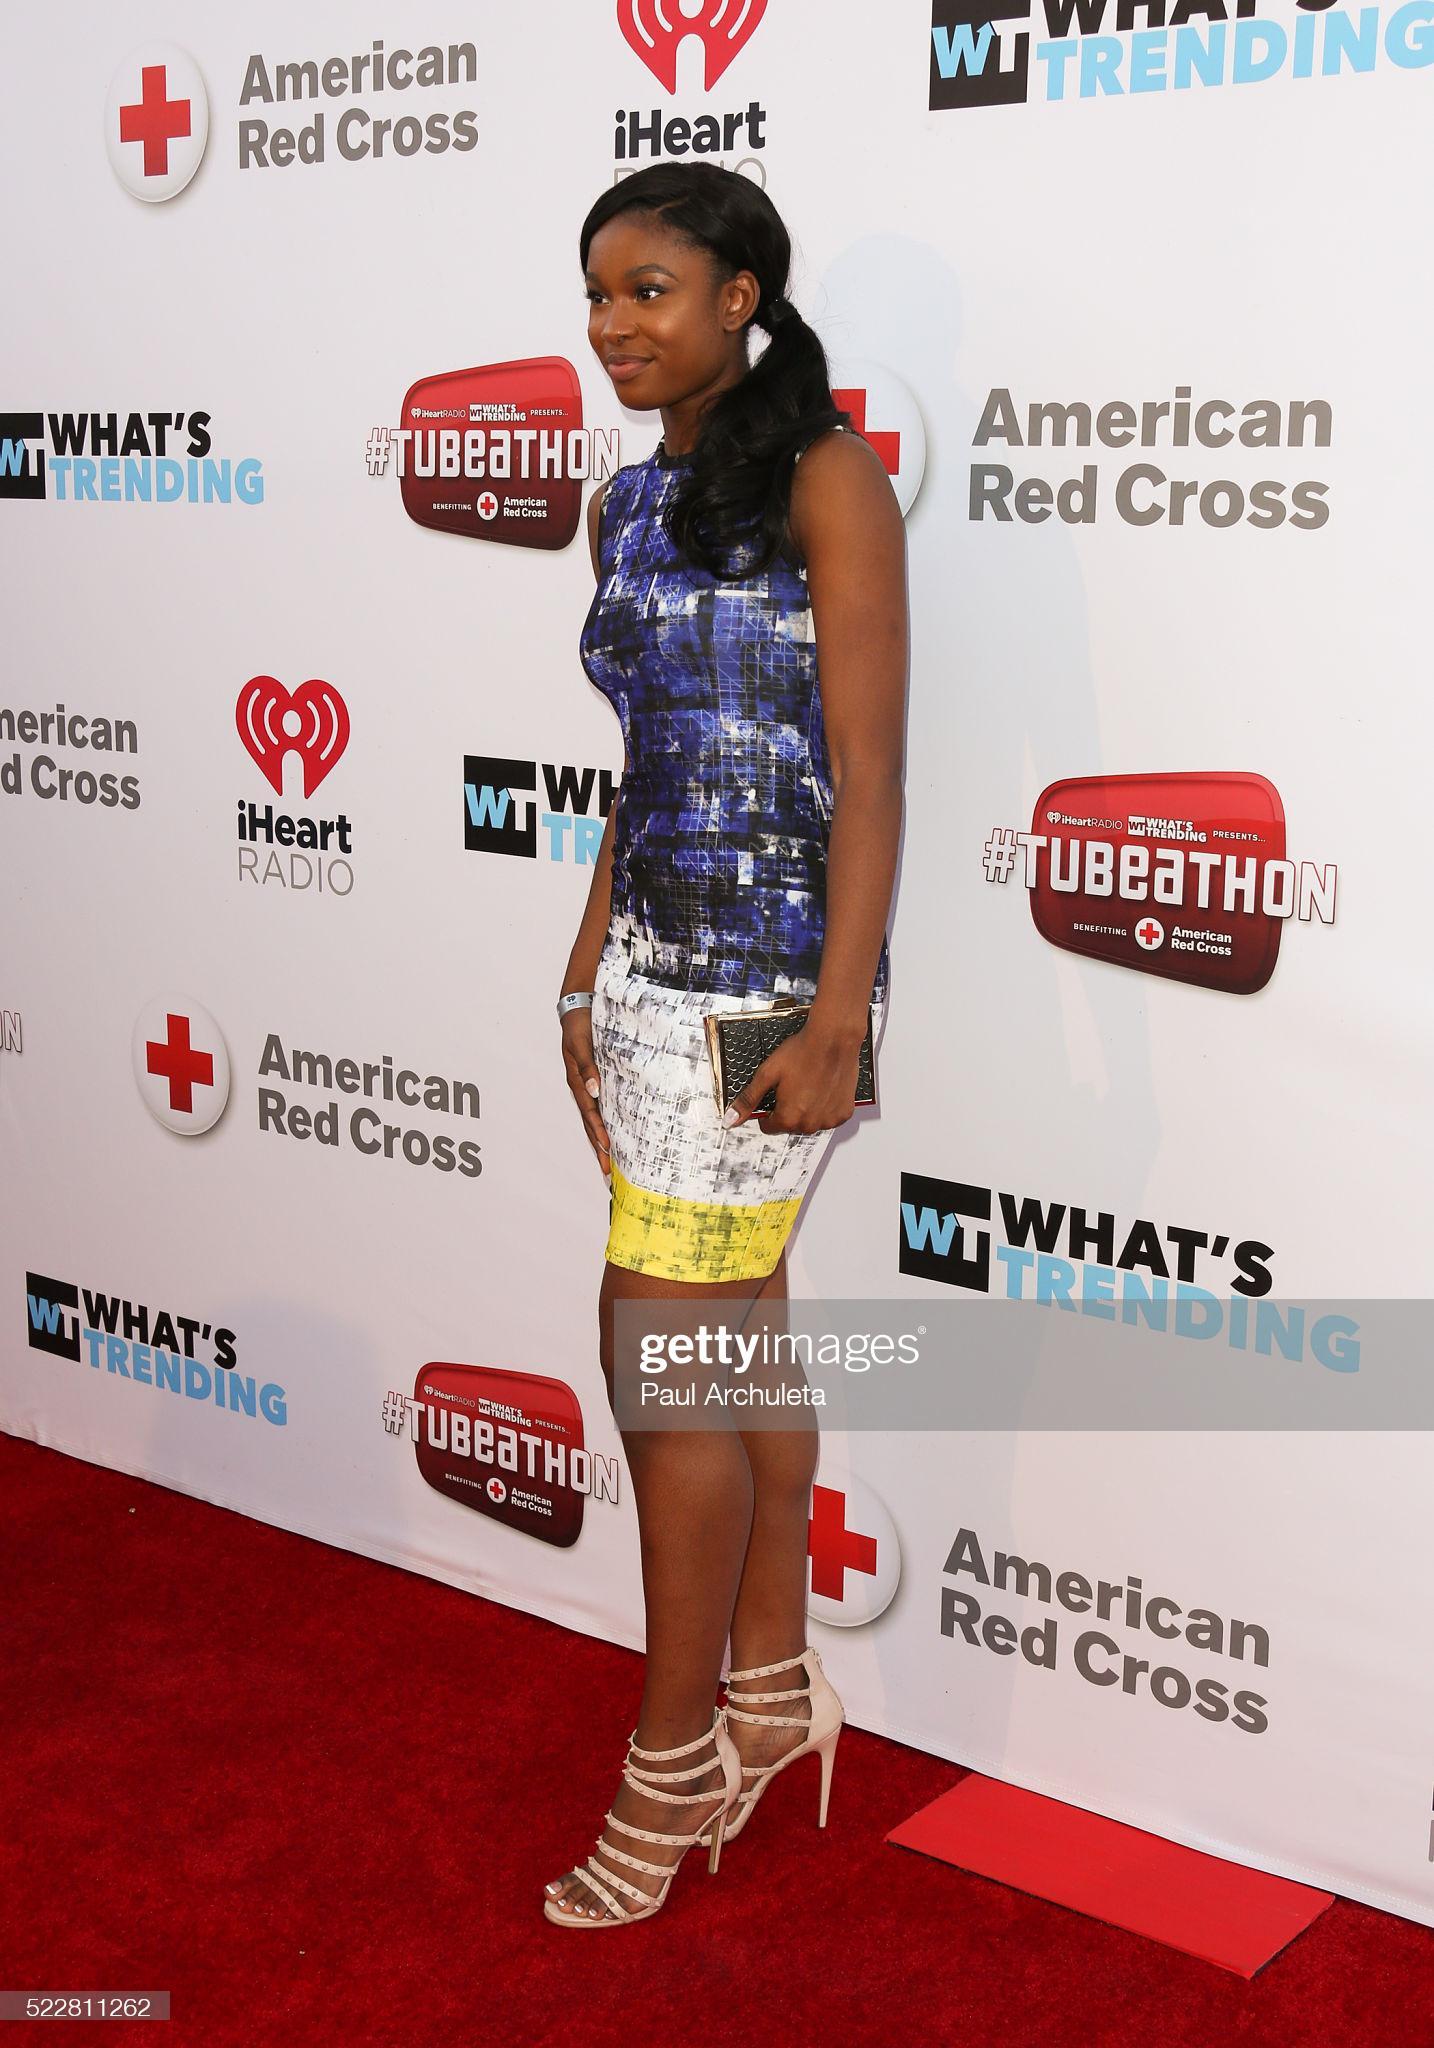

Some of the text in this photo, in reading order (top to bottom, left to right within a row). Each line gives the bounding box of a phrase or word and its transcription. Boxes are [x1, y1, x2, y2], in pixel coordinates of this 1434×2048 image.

[239, 41, 477, 105] American
[1036, 0, 1434, 101] TRENDING
[239, 108, 479, 169] Red Cross
[614, 102, 766, 159] iHeart
[482, 404, 516, 413] WHAT'S
[482, 412, 526, 421] TRENDING
[972, 386, 1333, 449] American
[48, 411, 212, 458] WHAT'S
[49, 457, 264, 505] TRENDING
[503, 496, 547, 507] American
[969, 463, 1331, 530] Red Cross
[503, 507, 547, 518] Red Cross
[31, 755, 140, 810] Cross
[238, 800, 352, 854] iHeart
[1061, 814, 1123, 830] iHeartRADIO
[1146, 817, 1194, 831] WHAT'S
[1146, 826, 1207, 843] TRENDING
[239, 847, 354, 896] RADIO
[1073, 923, 1127, 936] BENEFITTING
[1171, 938, 1232, 956] Red Cross
[1172, 926, 1232, 943] American
[257, 1033, 481, 1119] American
[258, 1087, 483, 1178] Red Cross
[997, 1192, 1275, 1298] WHAT'S
[81, 1288, 237, 1370] WHAT'S
[997, 1245, 1361, 1374] TRENDING
[83, 1327, 287, 1426] TRENDING
[490, 1401, 522, 1417] WHAT'S
[490, 1409, 532, 1428] TRENDING
[445, 1473, 482, 1489] BENEFITTING
[511, 1487, 552, 1506] American
[511, 1496, 552, 1517] Red Cross
[942, 1527, 1270, 1667] American
[940, 1587, 1269, 1734] Red Cross
